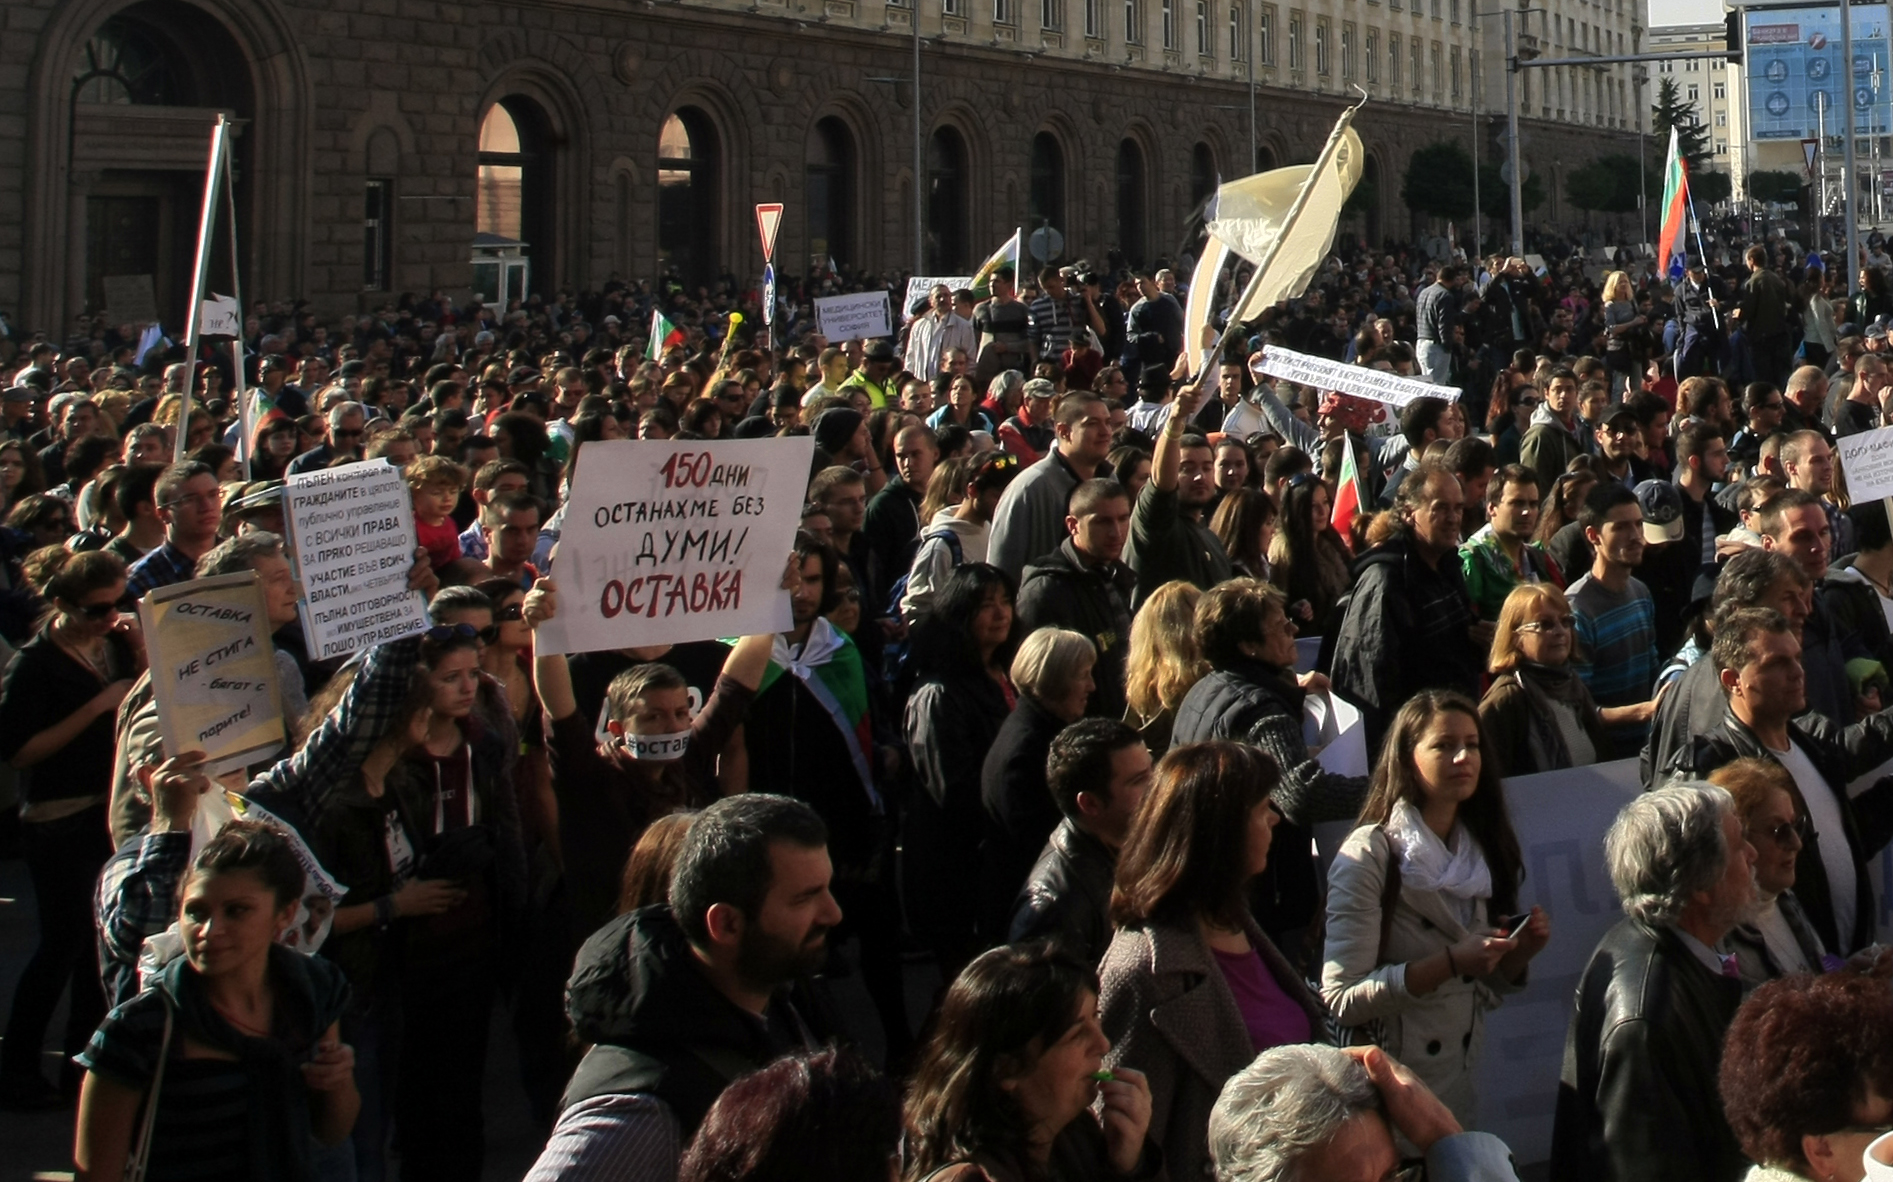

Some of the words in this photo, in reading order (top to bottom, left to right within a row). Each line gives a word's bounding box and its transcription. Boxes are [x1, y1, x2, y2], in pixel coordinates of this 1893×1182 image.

[822, 300, 882, 314] МЕДИЦИНСКИ
[822, 310, 883, 324] УНИВЕРСИТЕТ
[838, 322, 870, 332] СОФИЯ
[297, 473, 335, 489] ПЪЛЕН
[660, 451, 712, 489] 150
[293, 486, 359, 509] ГРАЖДАНИТЕ
[299, 509, 344, 529] публично
[345, 499, 400, 521] управление
[594, 498, 719, 528] ОСТАНАХМЕ
[732, 495, 765, 516] БЕЗ
[315, 524, 360, 545] ВСИЧКИ
[362, 516, 400, 535] ПРАВА
[302, 553, 316, 567] ЗА
[318, 545, 353, 564] ПРЯКО
[354, 534, 407, 555] РЕШАВАЩО
[635, 526, 750, 567] ДУМИ!
[310, 565, 356, 587] УЧАСТИЕ
[357, 559, 379, 575] ВЪВ
[600, 569, 743, 619] ОСТАВКА
[176, 602, 253, 623] ОСТАВКА
[314, 606, 349, 625] ПЪЛНА
[337, 609, 403, 635] ИМУЩЕСТВЕНА
[179, 659, 201, 680] НЕ
[205, 635, 255, 666] СТИГА
[323, 638, 355, 656] ЛОШО
